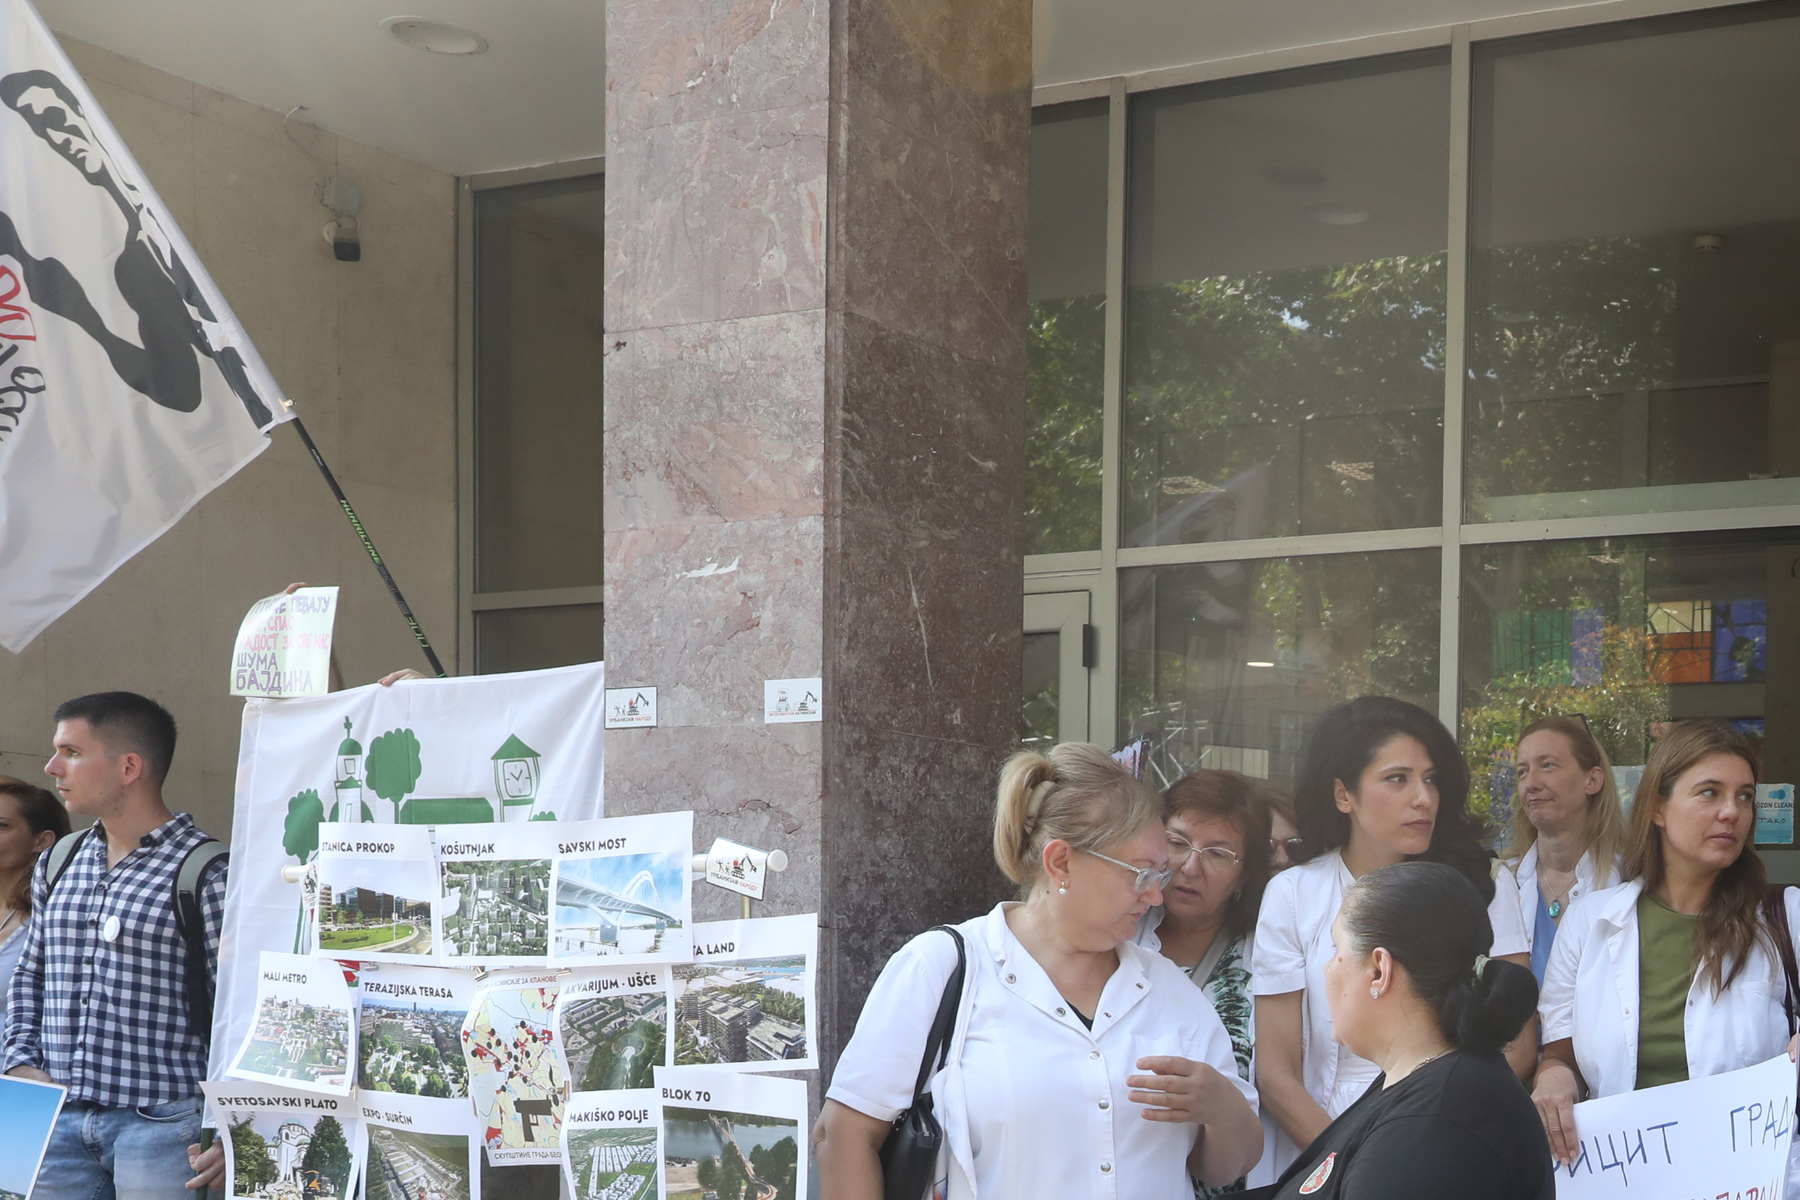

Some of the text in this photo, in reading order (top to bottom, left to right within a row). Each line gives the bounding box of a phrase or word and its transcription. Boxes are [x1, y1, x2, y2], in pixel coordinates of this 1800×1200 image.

[340, 499, 382, 565] HURRICANE
[405, 616, 430, 648] 300
[290, 595, 331, 615] ПЕВАЈУ
[238, 633, 279, 652] РАДОСТ
[237, 652, 278, 671] ШУМА
[236, 669, 314, 695] БАЈДИНА
[322, 841, 396, 854] STANICA PROKOP
[440, 841, 496, 857] KOŠUTNJAK
[558, 838, 627, 854] SAVSKI MOST
[706, 942, 735, 955] LAND
[263, 970, 308, 985] MALI METRO
[530, 975, 557, 985] КЛАНОВЕ
[564, 978, 619, 995] AKVARIJUM
[628, 971, 657, 987] UŠĆE
[364, 981, 454, 999] TERAZIJSKA TERASA
[662, 1087, 711, 1103] BLOK 70
[217, 1096, 339, 1111] SVETOSAVSKI PLATO
[362, 1107, 381, 1120] EXPO
[385, 1111, 414, 1126] SURČIN
[569, 1107, 649, 1124] MAKIŠKO POLJE
[532, 1151, 550, 1159] ГРАДА
